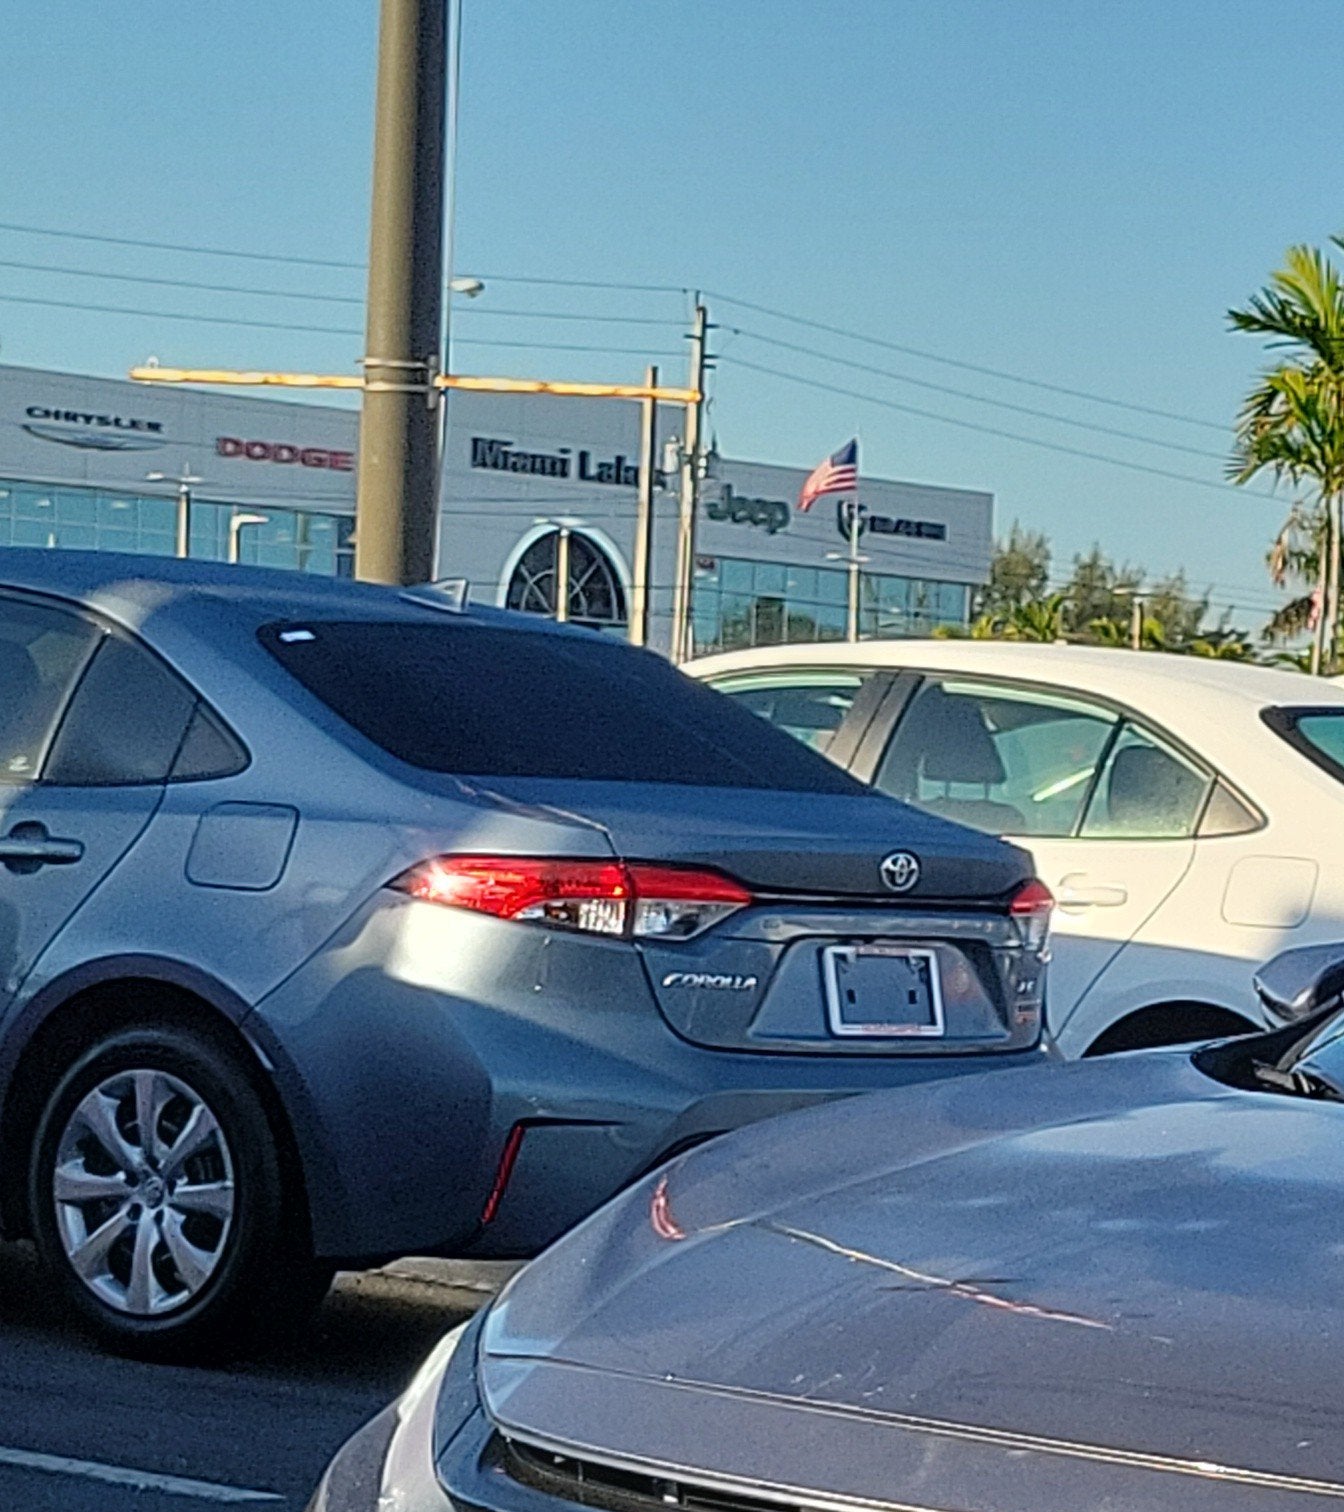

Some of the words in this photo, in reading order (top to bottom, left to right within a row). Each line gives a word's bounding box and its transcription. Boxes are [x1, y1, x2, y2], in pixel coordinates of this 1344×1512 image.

[26, 406, 163, 433] CHRYSLER
[216, 437, 355, 472] DODGE
[471, 437, 571, 478] Miami
[706, 484, 790, 534] Jeep
[662, 973, 758, 989] COROLLA
